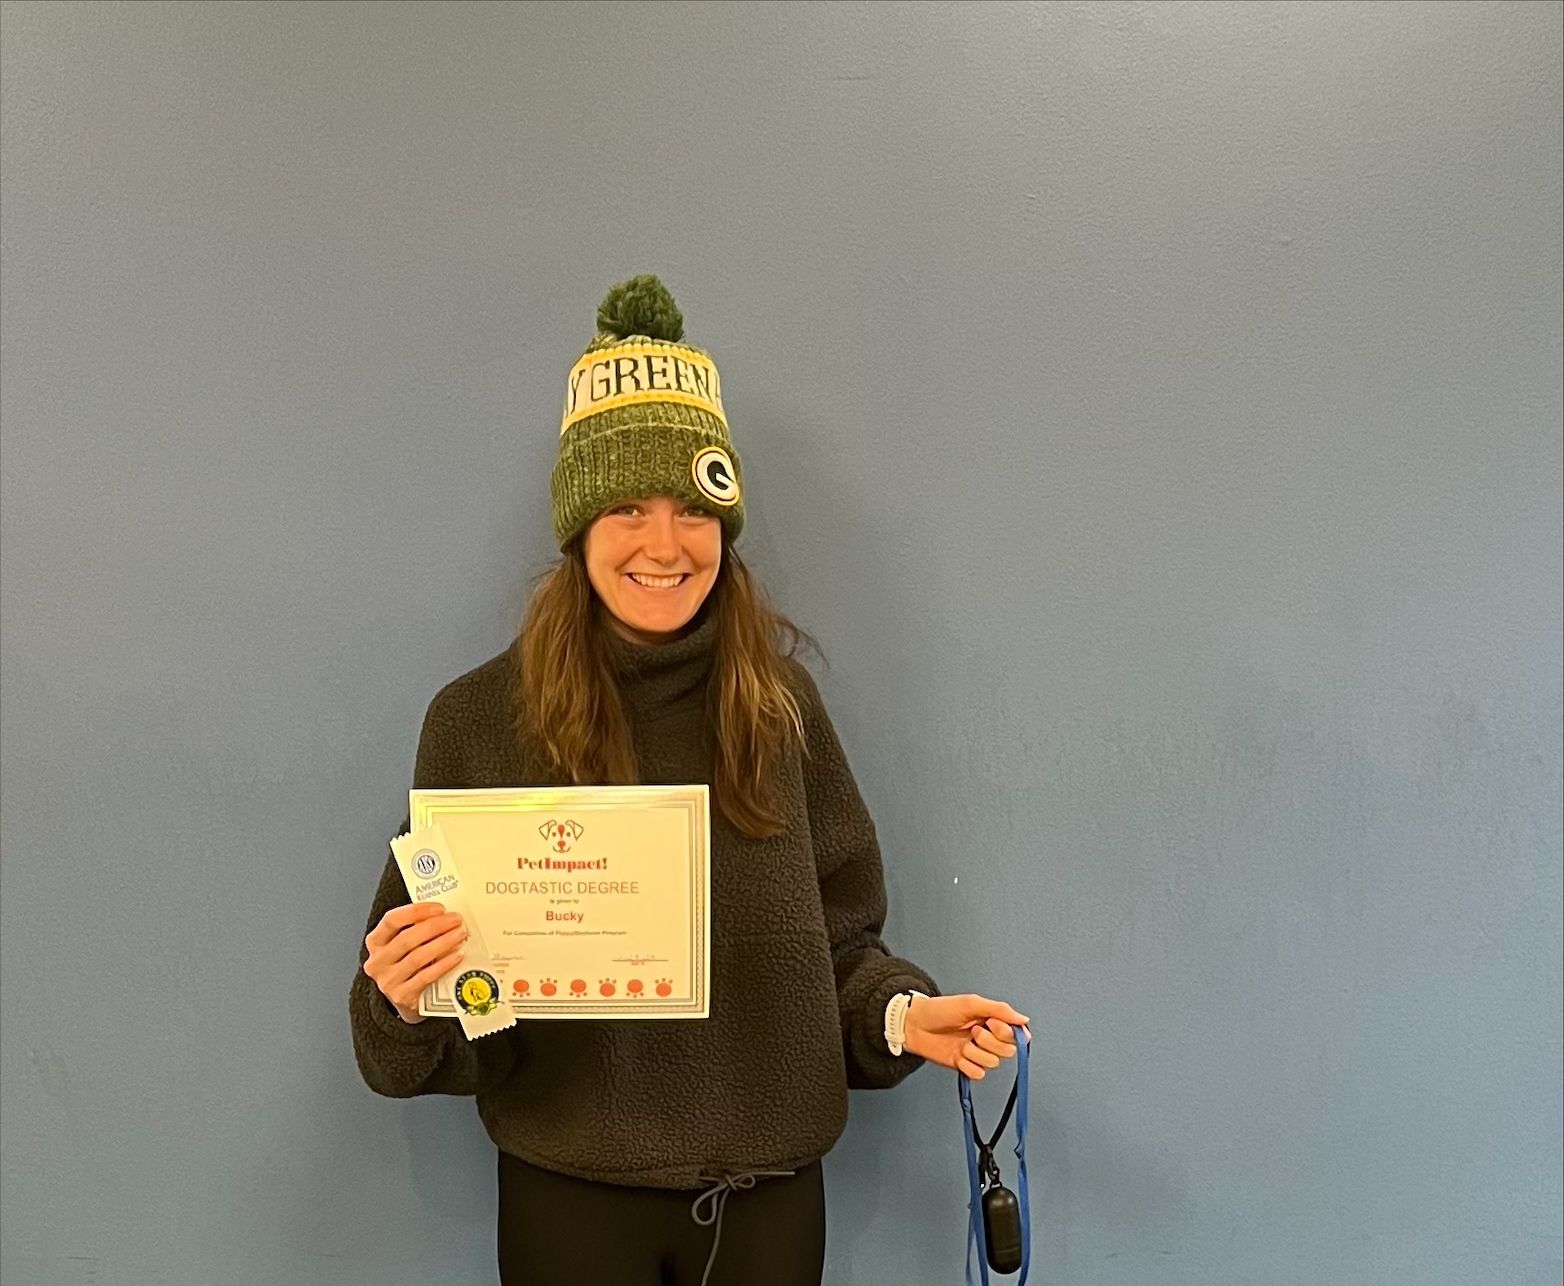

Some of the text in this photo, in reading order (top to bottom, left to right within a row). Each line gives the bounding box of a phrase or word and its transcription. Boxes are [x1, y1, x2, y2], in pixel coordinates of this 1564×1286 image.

[590, 354, 713, 406] GREEN
[517, 857, 608, 873] PetImpact!
[485, 881, 640, 894] DOGTASTIC DEGREE
[545, 910, 584, 924] Bucky
